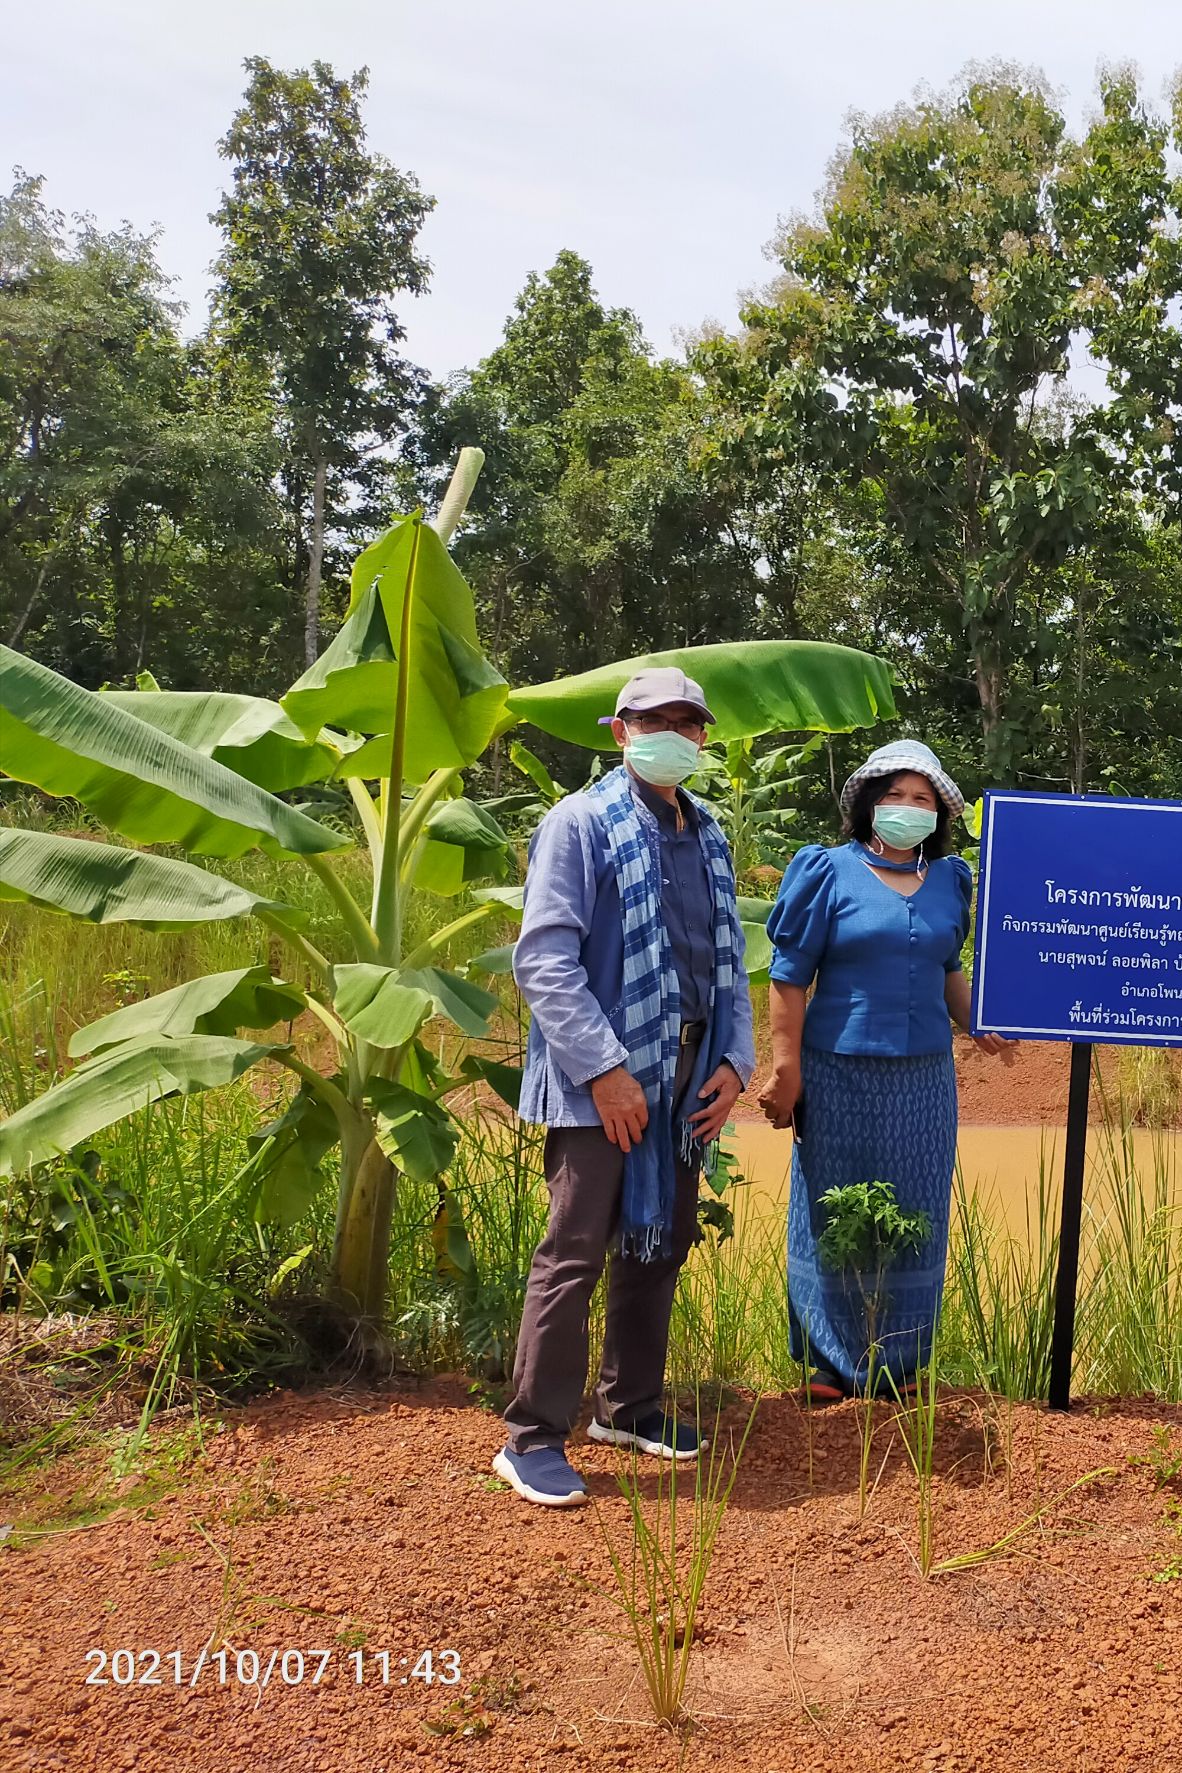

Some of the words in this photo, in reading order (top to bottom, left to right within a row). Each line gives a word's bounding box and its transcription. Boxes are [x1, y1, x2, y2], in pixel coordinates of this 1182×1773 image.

[1038, 949, 1108, 970] นายสุพจน์
[1111, 953, 1168, 970] ลอยพิลา
